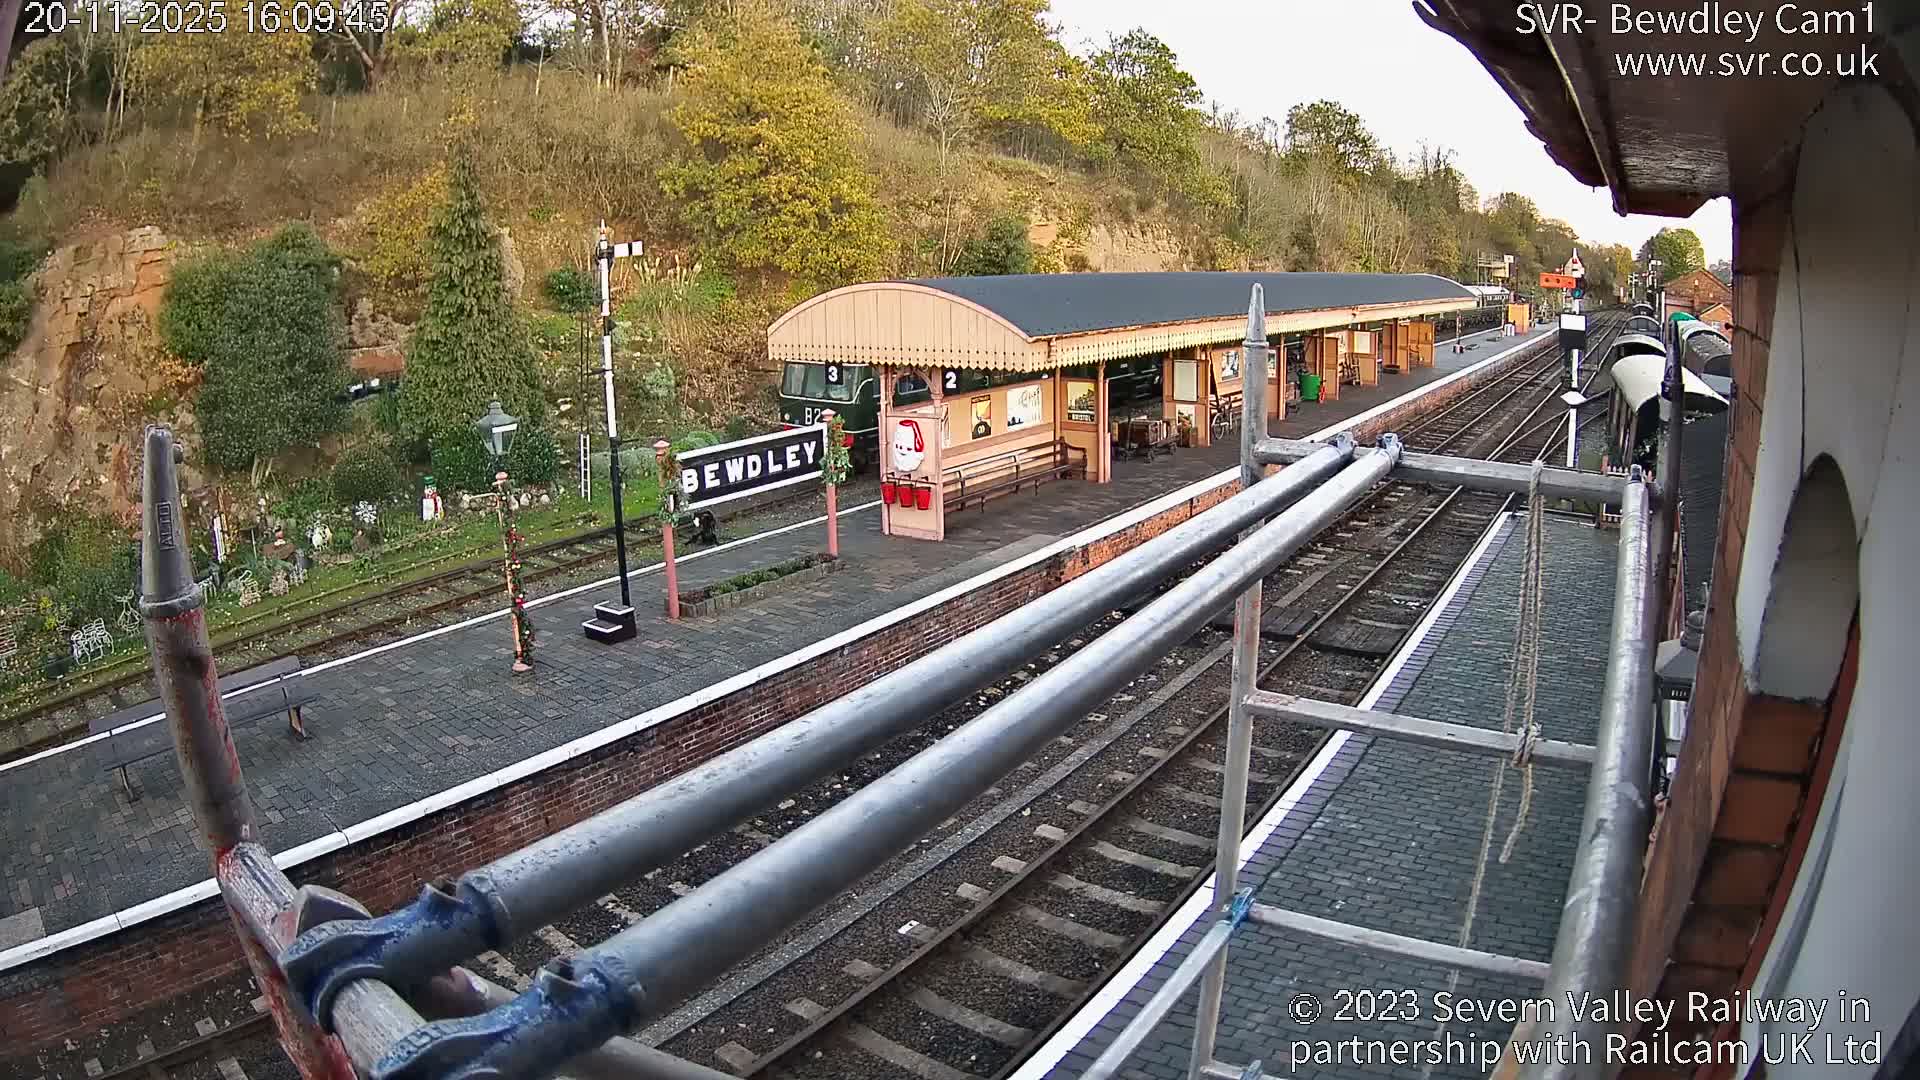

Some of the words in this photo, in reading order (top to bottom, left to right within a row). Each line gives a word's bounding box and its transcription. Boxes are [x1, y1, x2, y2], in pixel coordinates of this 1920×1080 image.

[828, 366, 838, 382] 3
[945, 371, 957, 389] 2
[681, 440, 817, 494] BEWDLEY
